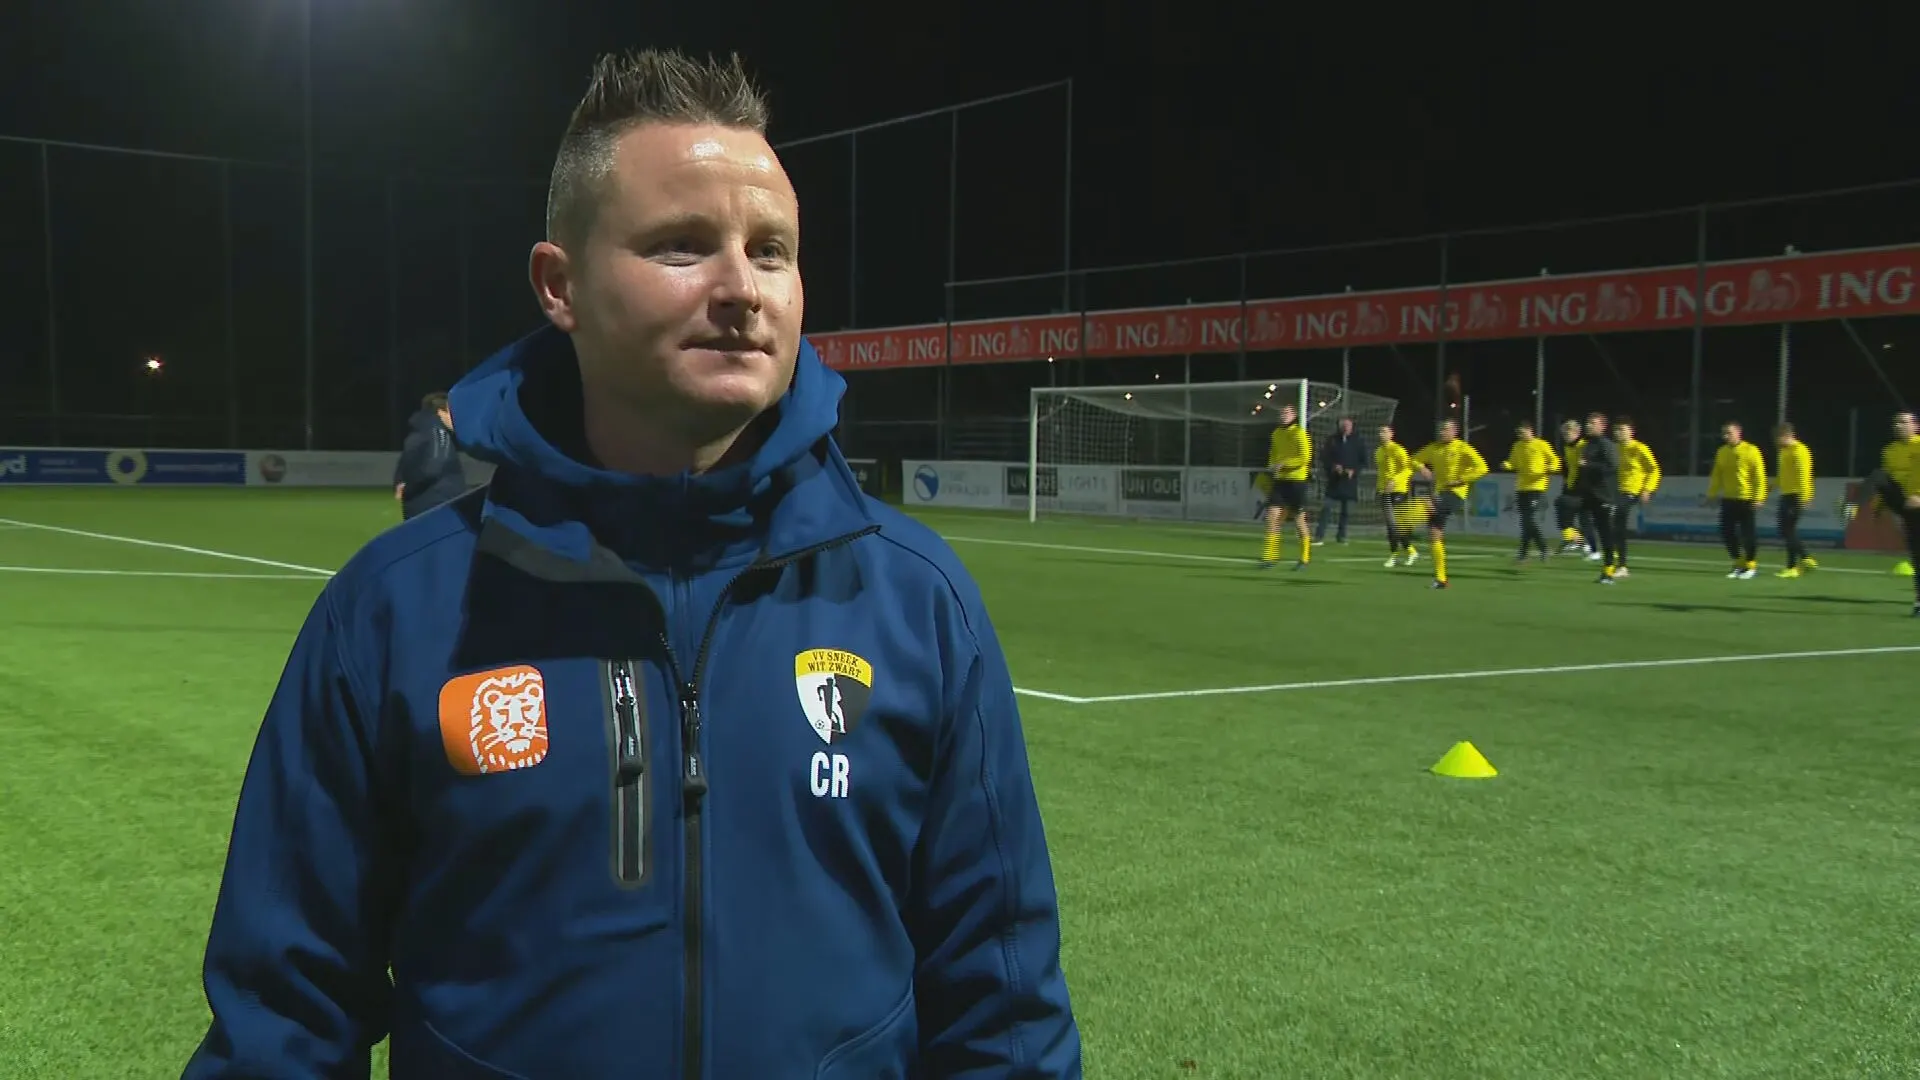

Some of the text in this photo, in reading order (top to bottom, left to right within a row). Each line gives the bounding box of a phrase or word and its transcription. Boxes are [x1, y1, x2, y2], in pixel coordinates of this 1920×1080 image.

[849, 340, 881, 365] ING
[907, 334, 940, 361] ING
[970, 331, 1006, 356] ING
[1039, 327, 1079, 353] ING
[1115, 323, 1159, 350] ING
[1294, 312, 1348, 341] ING
[1517, 295, 1587, 328] ING
[1655, 281, 1737, 319] ING
[1814, 266, 1914, 309] ING
[808, 662, 862, 678] WIT ZWART
[811, 651, 859, 667] VV SNEEK
[810, 751, 850, 798] CR
